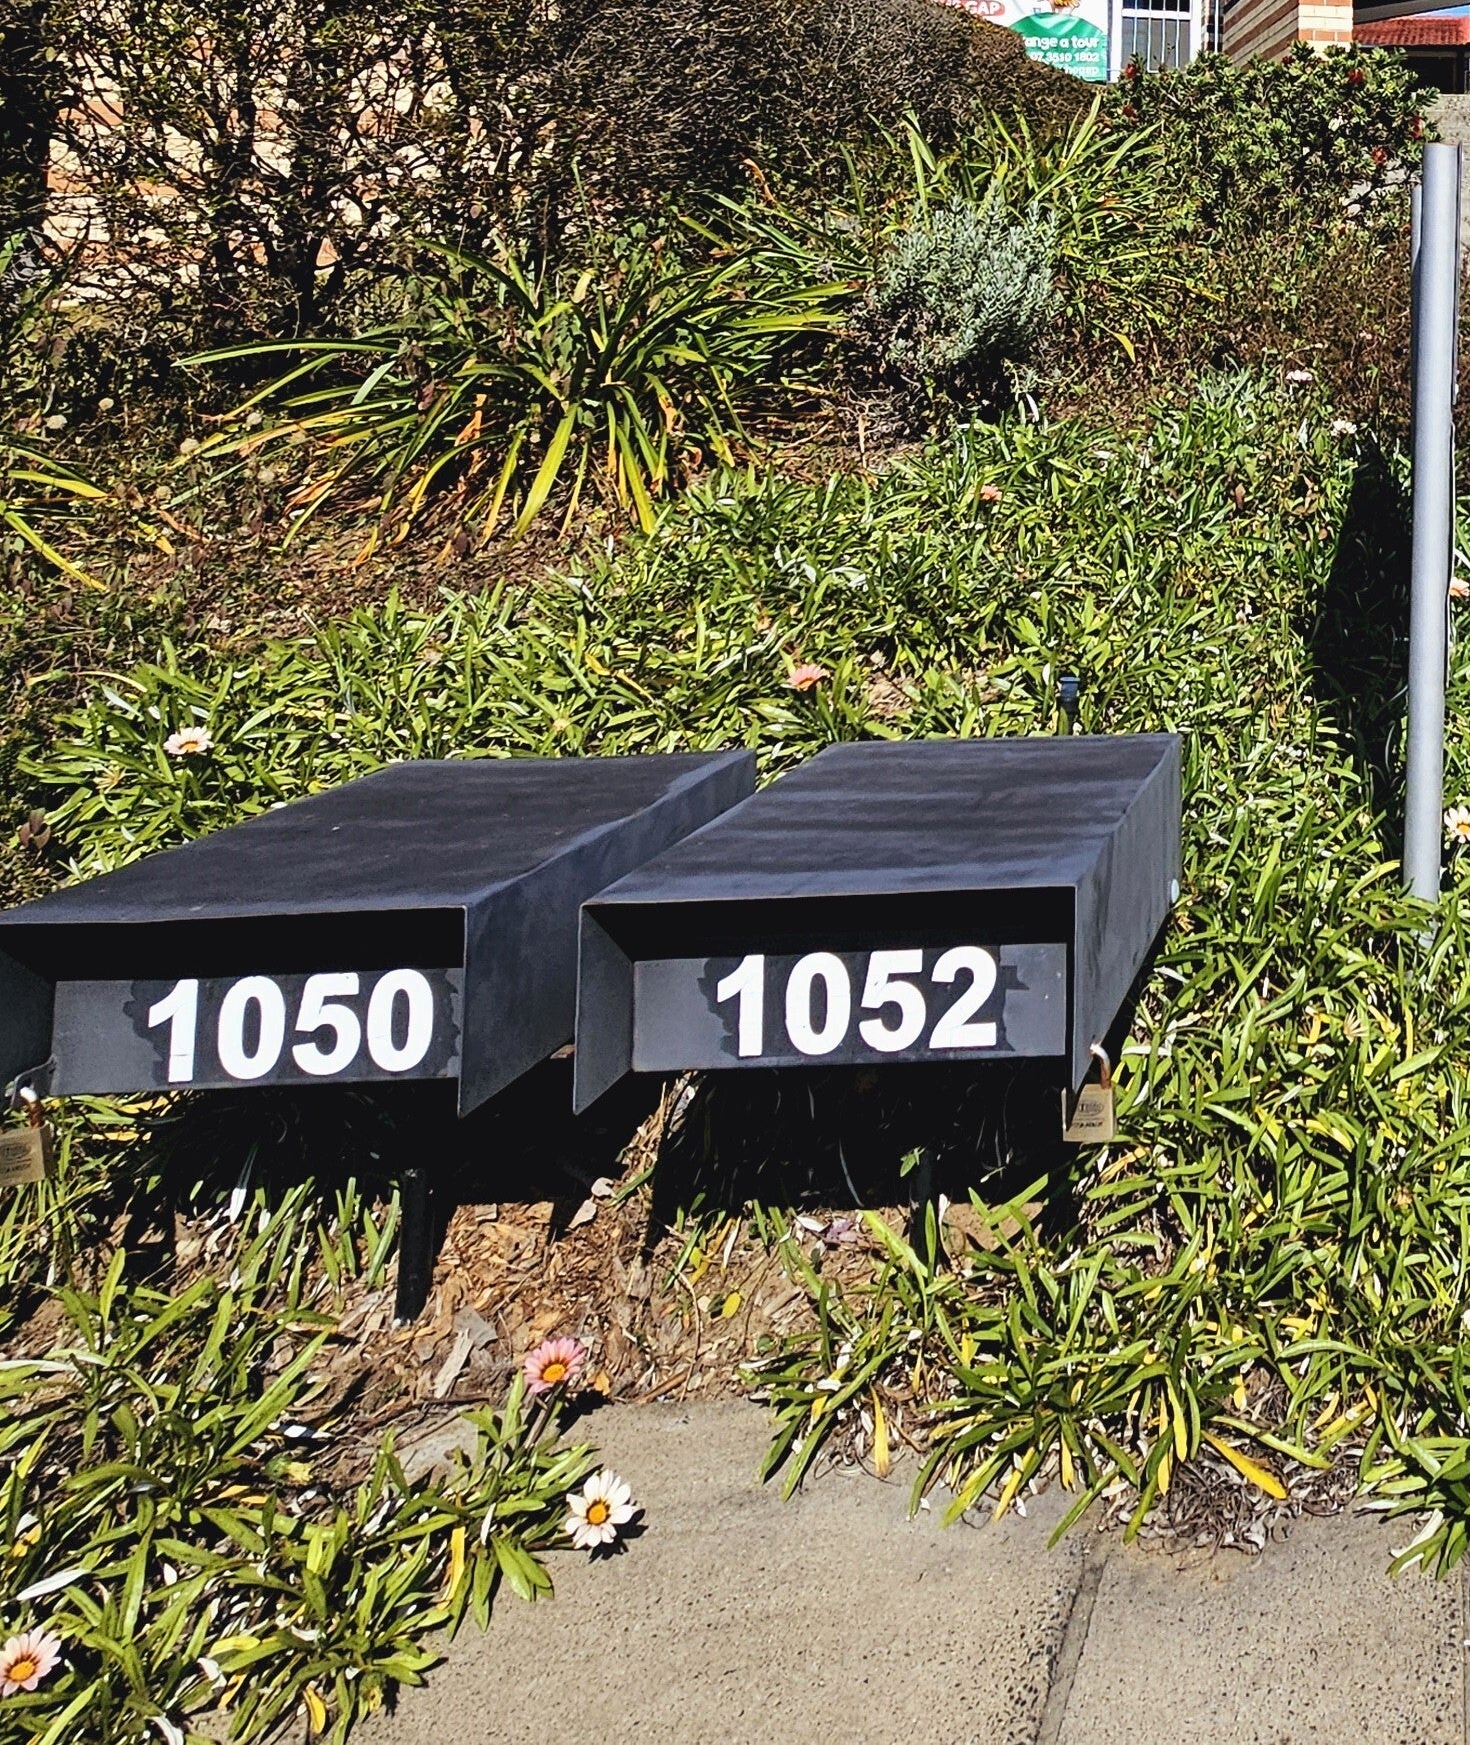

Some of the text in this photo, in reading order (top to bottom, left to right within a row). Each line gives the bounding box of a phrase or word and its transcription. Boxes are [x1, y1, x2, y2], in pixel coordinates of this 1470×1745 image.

[965, 0, 1001, 16] GAP
[1059, 38, 1070, 49] a
[1071, 34, 1100, 49] tour
[148, 968, 434, 1083] 1050
[717, 945, 997, 1057] 1052
